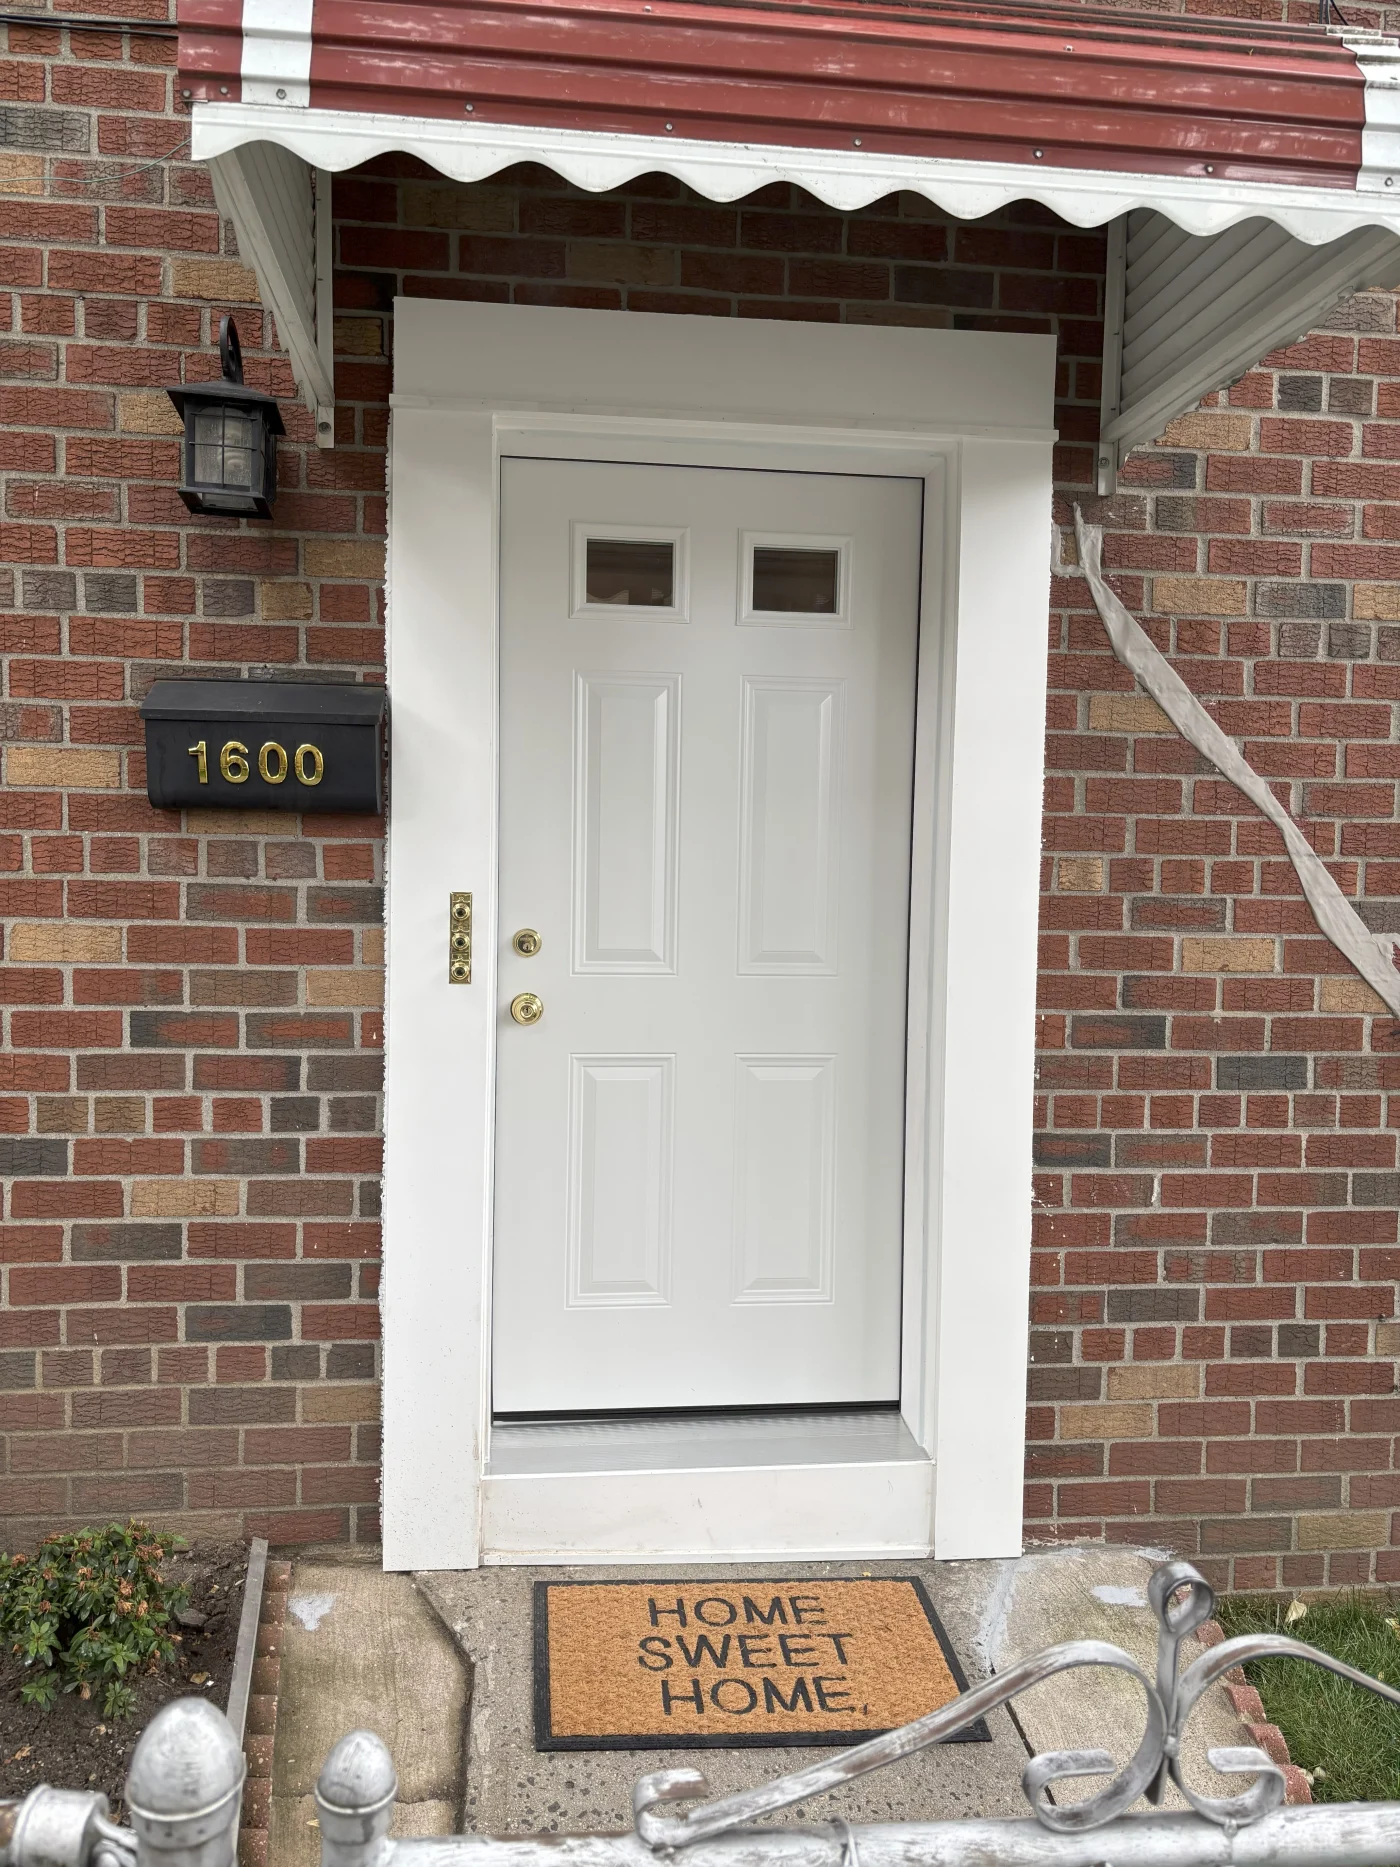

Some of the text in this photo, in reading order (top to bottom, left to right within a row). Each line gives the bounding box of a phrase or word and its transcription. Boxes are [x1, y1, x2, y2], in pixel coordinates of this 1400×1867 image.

[188, 741, 324, 786] 1600
[648, 1596, 827, 1628] HOME
[638, 1633, 852, 1672] SWEET
